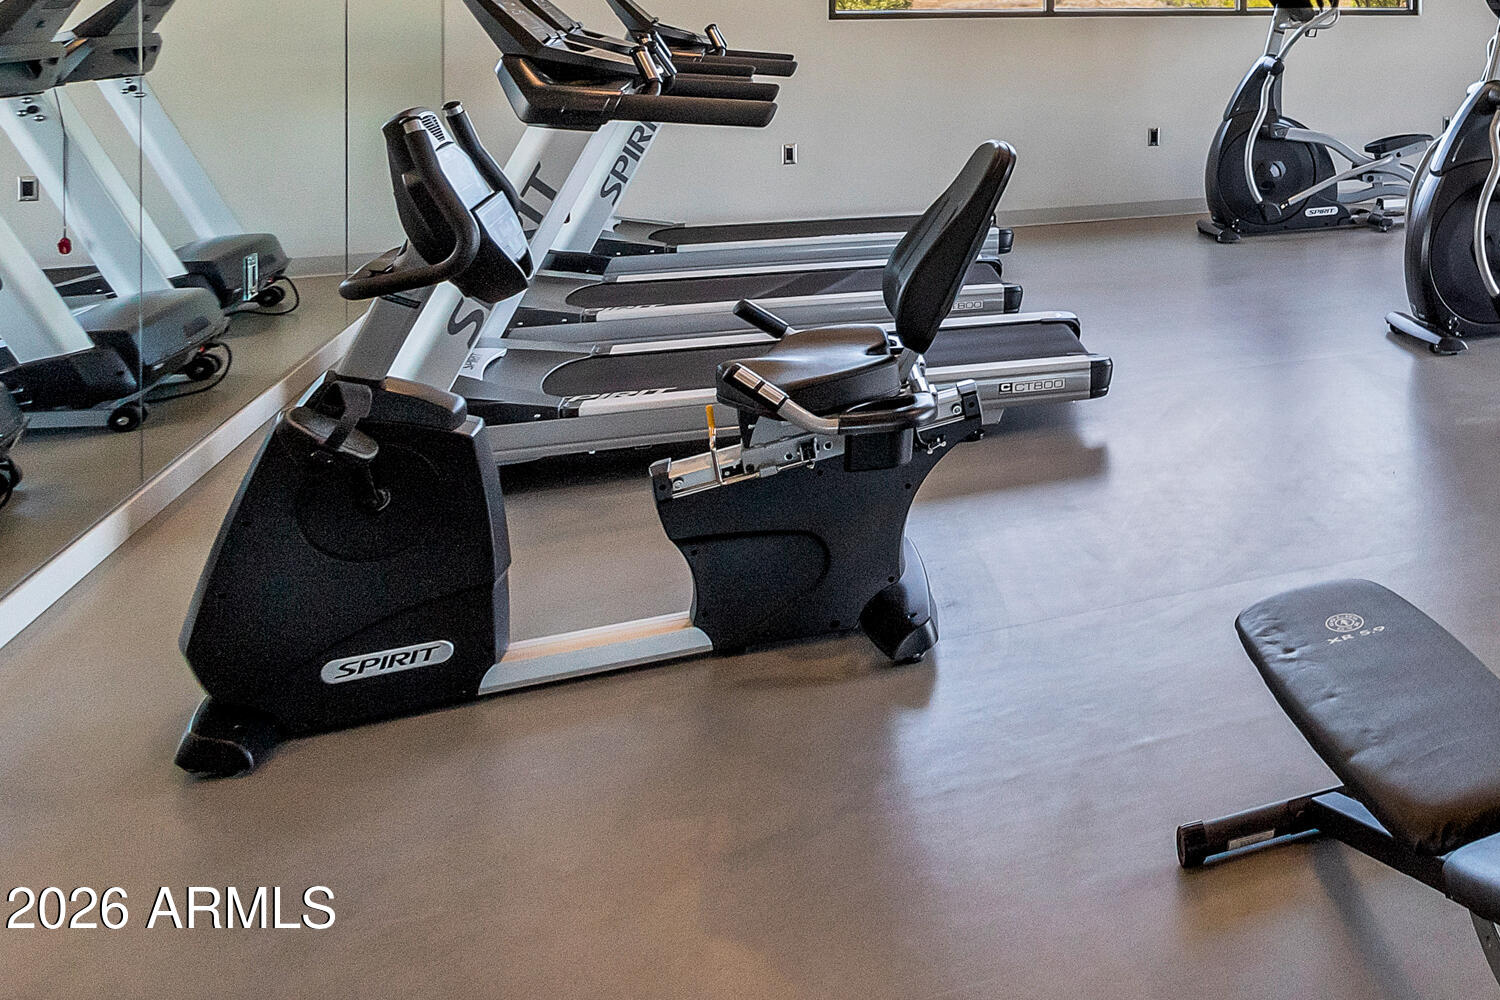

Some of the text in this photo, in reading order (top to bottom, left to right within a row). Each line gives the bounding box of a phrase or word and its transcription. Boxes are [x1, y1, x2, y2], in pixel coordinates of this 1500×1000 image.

[600, 120, 658, 208] SPIRI
[1014, 379, 1064, 392] CT800
[1327, 633, 1355, 645] XR
[333, 645, 442, 680] SPIRIT
